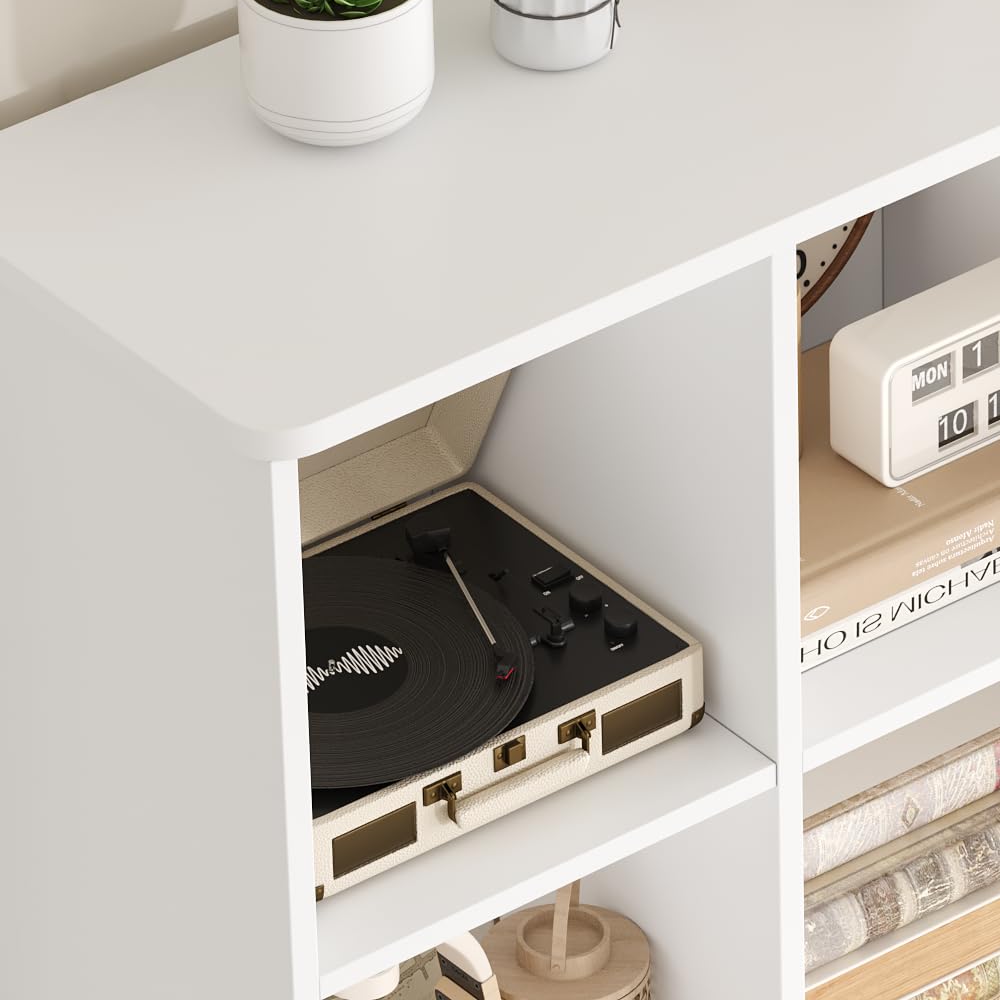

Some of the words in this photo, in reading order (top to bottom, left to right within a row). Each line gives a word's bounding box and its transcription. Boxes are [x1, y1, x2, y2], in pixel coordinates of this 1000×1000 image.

[912, 360, 948, 391] MON
[972, 340, 982, 367] 1
[939, 409, 968, 441] 10
[945, 529, 973, 546] Afonso
[974, 519, 995, 533] Nadir
